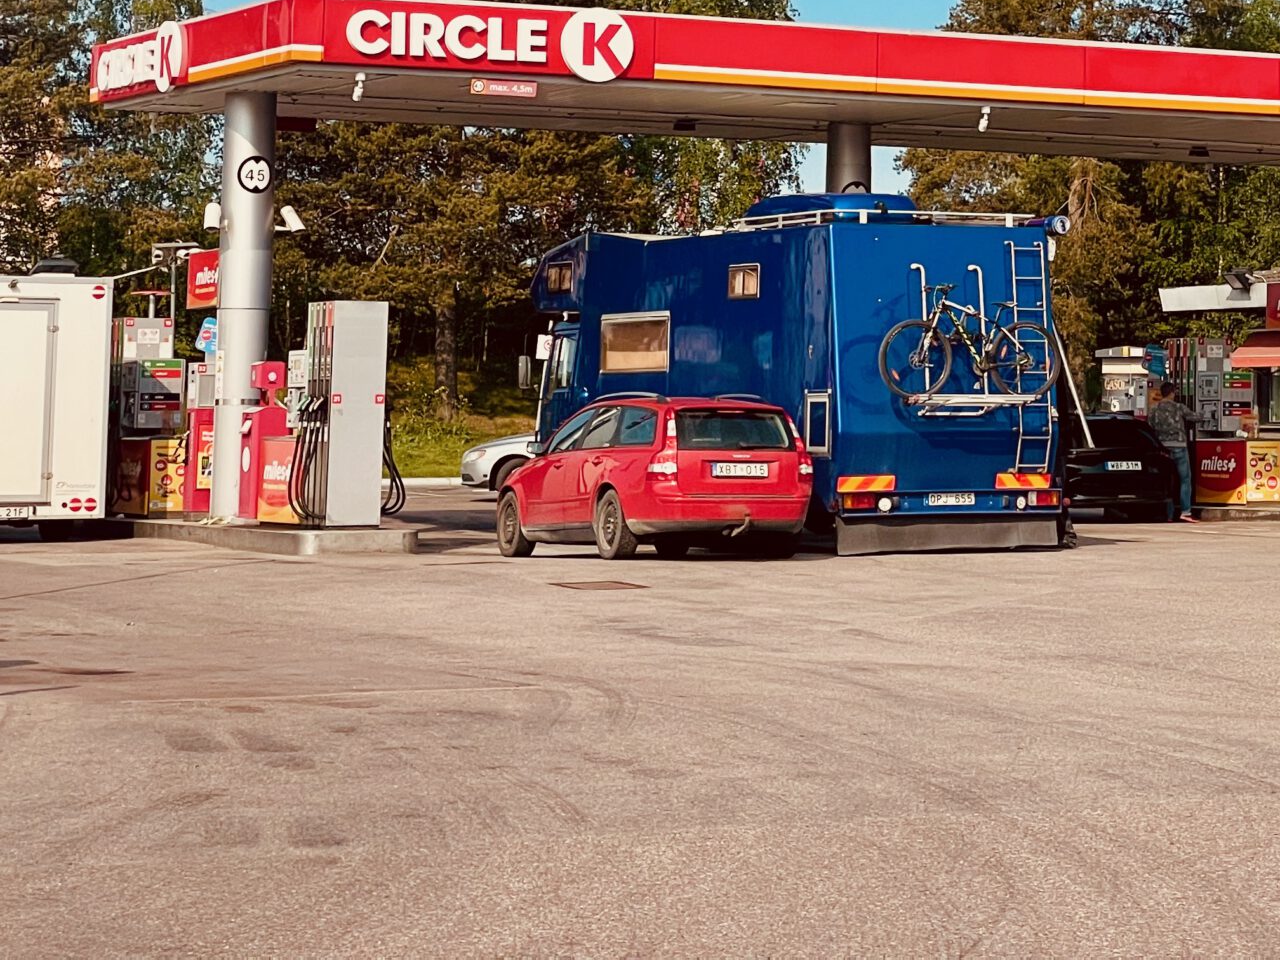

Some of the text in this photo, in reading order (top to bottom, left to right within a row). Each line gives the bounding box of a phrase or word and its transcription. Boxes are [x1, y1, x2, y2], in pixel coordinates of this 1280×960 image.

[346, 9, 626, 77] CIRCLE K
[245, 169, 265, 182] 45
[719, 464, 766, 475] XBT 015
[1200, 455, 1237, 473] miles+
[6, 508, 24, 517] 21F
